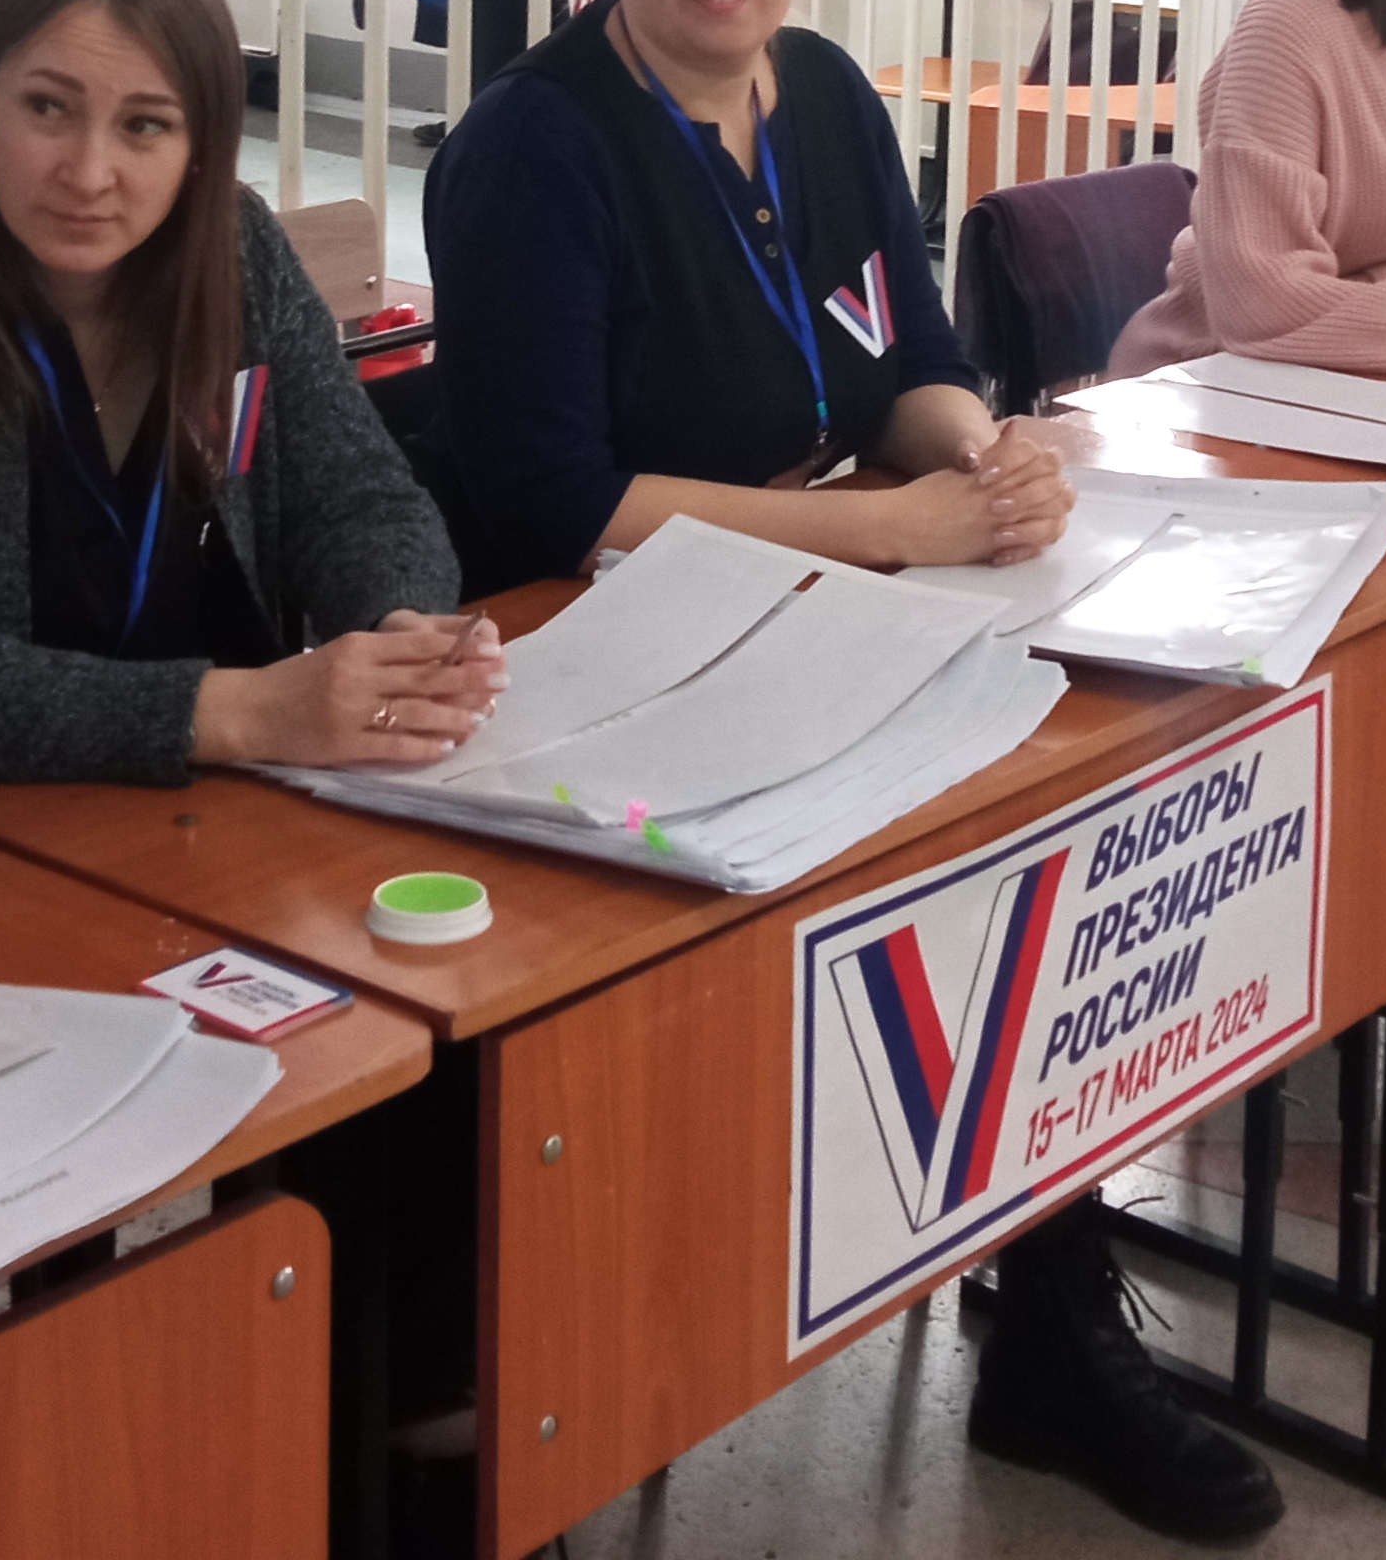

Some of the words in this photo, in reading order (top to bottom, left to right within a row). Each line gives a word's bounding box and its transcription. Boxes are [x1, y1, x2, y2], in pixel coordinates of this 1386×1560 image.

[1085, 751, 1263, 892] ВЫБОРЫ
[1063, 805, 1308, 988] ПРЕЗИДЕНТА
[1038, 936, 1207, 1083] РОССИИ
[1108, 1013, 1202, 1116] МАРТА
[1206, 974, 1270, 1055] 2024
